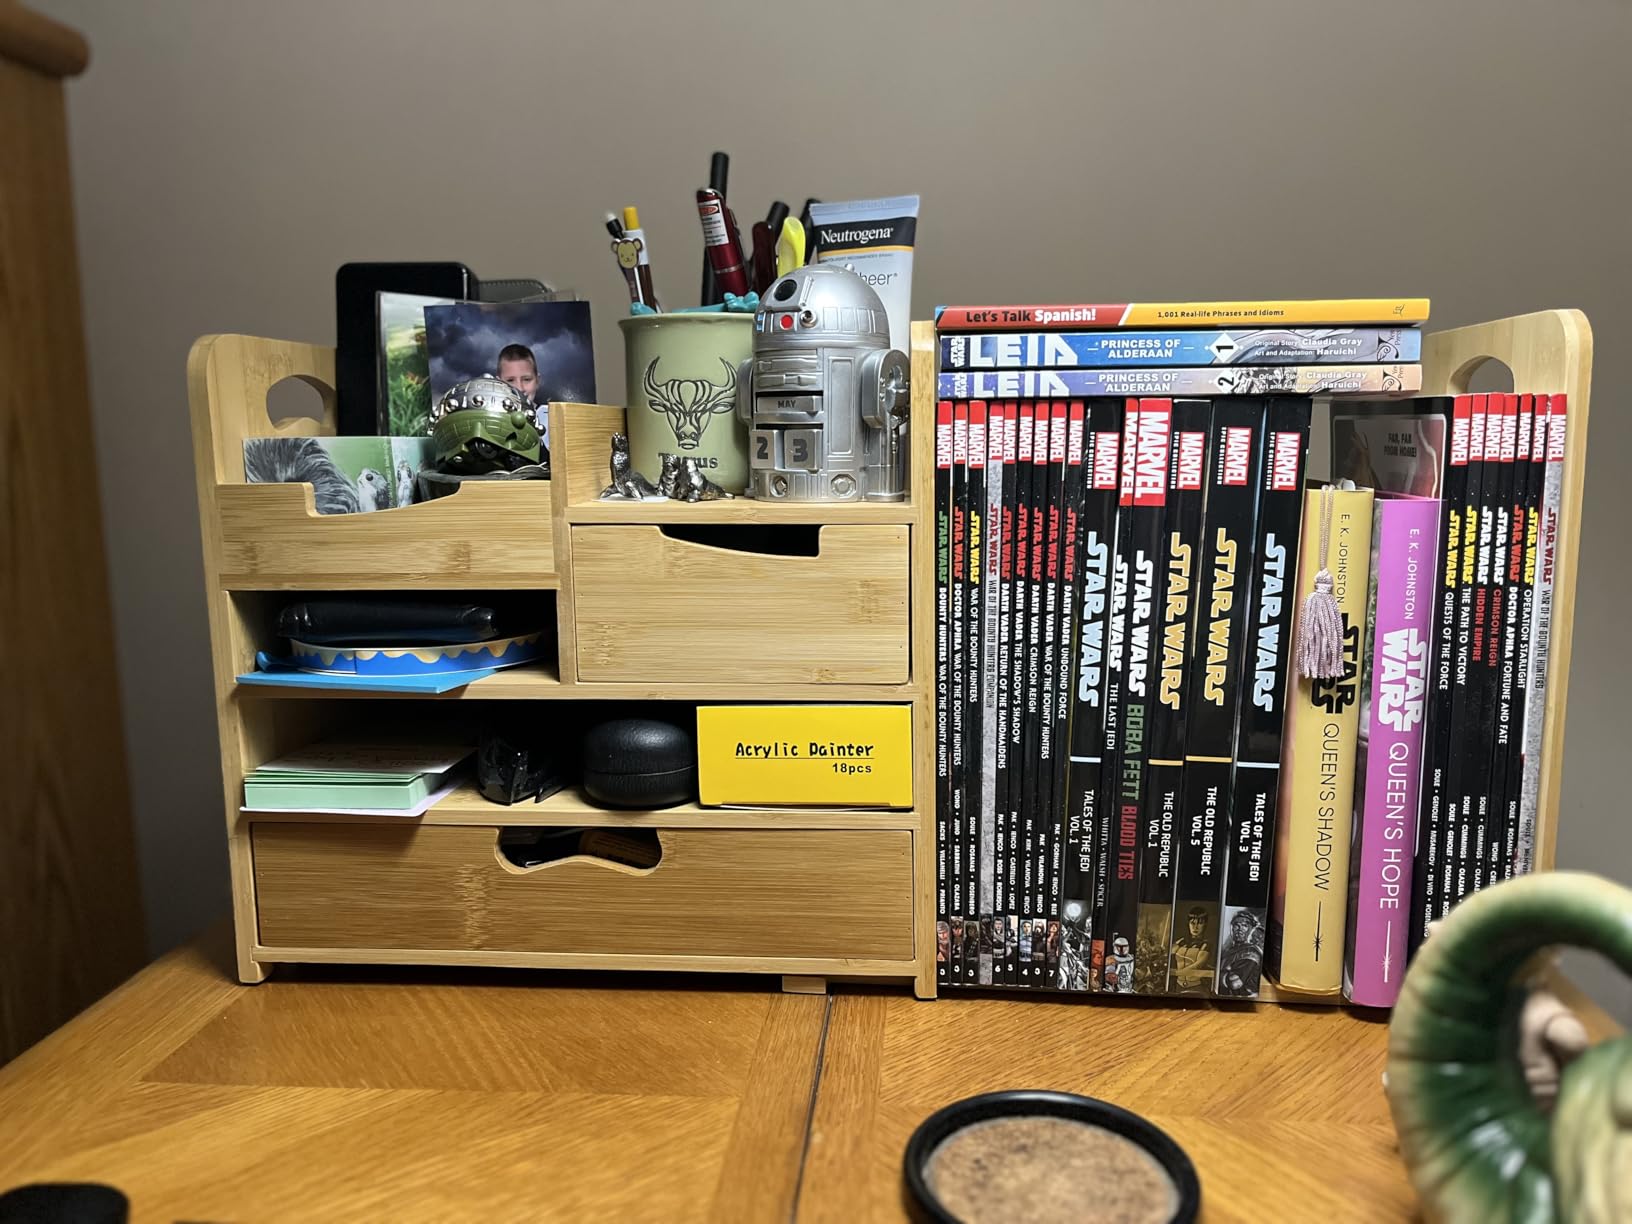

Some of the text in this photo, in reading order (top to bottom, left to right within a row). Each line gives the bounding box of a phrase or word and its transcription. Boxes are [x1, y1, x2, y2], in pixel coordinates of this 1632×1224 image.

[820, 226, 890, 245] Neutrogena
[966, 308, 1097, 324] Let's Talk Spanish!
[1180, 310, 1211, 318] Real-life
[970, 334, 1078, 368] LEIA
[1102, 339, 1181, 349] PRINCESS OF
[1108, 349, 1173, 358] ALDERAAN
[1216, 344, 1234, 354] 1
[1302, 338, 1338, 346] Claudia
[1340, 338, 1363, 347] Gray
[1316, 348, 1357, 356] Haruichi
[973, 372, 1070, 397] LEIA
[1099, 373, 1181, 383] PRINCESS OF
[1106, 383, 1170, 392] ALDERAAN
[1218, 377, 1234, 388] 2
[778, 400, 796, 409] MAY
[756, 437, 809, 462] 2 3
[1003, 419, 1016, 463] MARVEL
[1019, 416, 1033, 460] MARVEL
[1034, 420, 1047, 463] MARVEL
[1068, 420, 1083, 463] MARVEL
[1120, 412, 1138, 498] MARVEL
[1134, 411, 1169, 499] MARVEL
[1225, 428, 1250, 484] MARVEL
[1485, 414, 1502, 461] MARVEL
[1500, 415, 1517, 461] MARVEL
[1533, 415, 1546, 461] MARVEL
[1094, 433, 1119, 489] MARVEL
[1177, 433, 1203, 489] MARVEL
[1274, 433, 1300, 489] MARVEL
[1336, 514, 1350, 604] E. K. JOHNSTON
[1405, 529, 1420, 620] E. K. JOHNSTON
[1473, 506, 1493, 661] STAR WARS HIDDEN EMPIRE
[1489, 507, 1508, 666] STAR WARS CRIMSON REIGN
[1518, 507, 1539, 688] STAR WARS OPERATION STARLIGHT
[1012, 503, 1028, 744] STAR WARS DARTH VADER THE SHADOW'S SHADOW
[1029, 507, 1043, 713] STAR WARS DARTH VADER CRIMSON REIGN
[1059, 507, 1076, 719] STAR WARS DARTH VADER UNBOUND FORCE
[1079, 531, 1108, 707] STAR WARS
[1160, 532, 1192, 710] STAR WARS
[1204, 528, 1238, 706] STAR WARS
[1252, 533, 1286, 712] STAR WARS
[998, 506, 1012, 769] STAR WARS DARTH VADER RETURN OF THE HANDMAIDENS
[1107, 554, 1128, 750] STAR WARS THE LAST JEDI
[1378, 628, 1409, 732] WARS
[1403, 628, 1427, 732] STAR
[1118, 550, 1154, 879] STAR WARS BOBA FETT BLOOD TIES
[736, 742, 798, 759] Acrylic
[833, 763, 872, 775] 18pcs
[1070, 816, 1080, 836] VOL.
[1192, 815, 1203, 837] VOL.
[1314, 723, 1340, 891] QUEEN'S SHADOW
[1380, 743, 1409, 909] QUEEN'S HOPE
[1463, 796, 1471, 815] SOULE
[1079, 790, 1094, 872] TALES OF THE JEDI
[1149, 819, 1160, 840] VOL.
[1159, 792, 1174, 877] THE OLD REPUBLIC
[1201, 787, 1217, 875] THE OLD REPUBLIC
[1240, 821, 1251, 843] VOL.
[1249, 793, 1266, 881] TALES OF THE JEDI
[1460, 824, 1469, 859] CUMMINGS
[1099, 853, 1107, 877] WALSH
